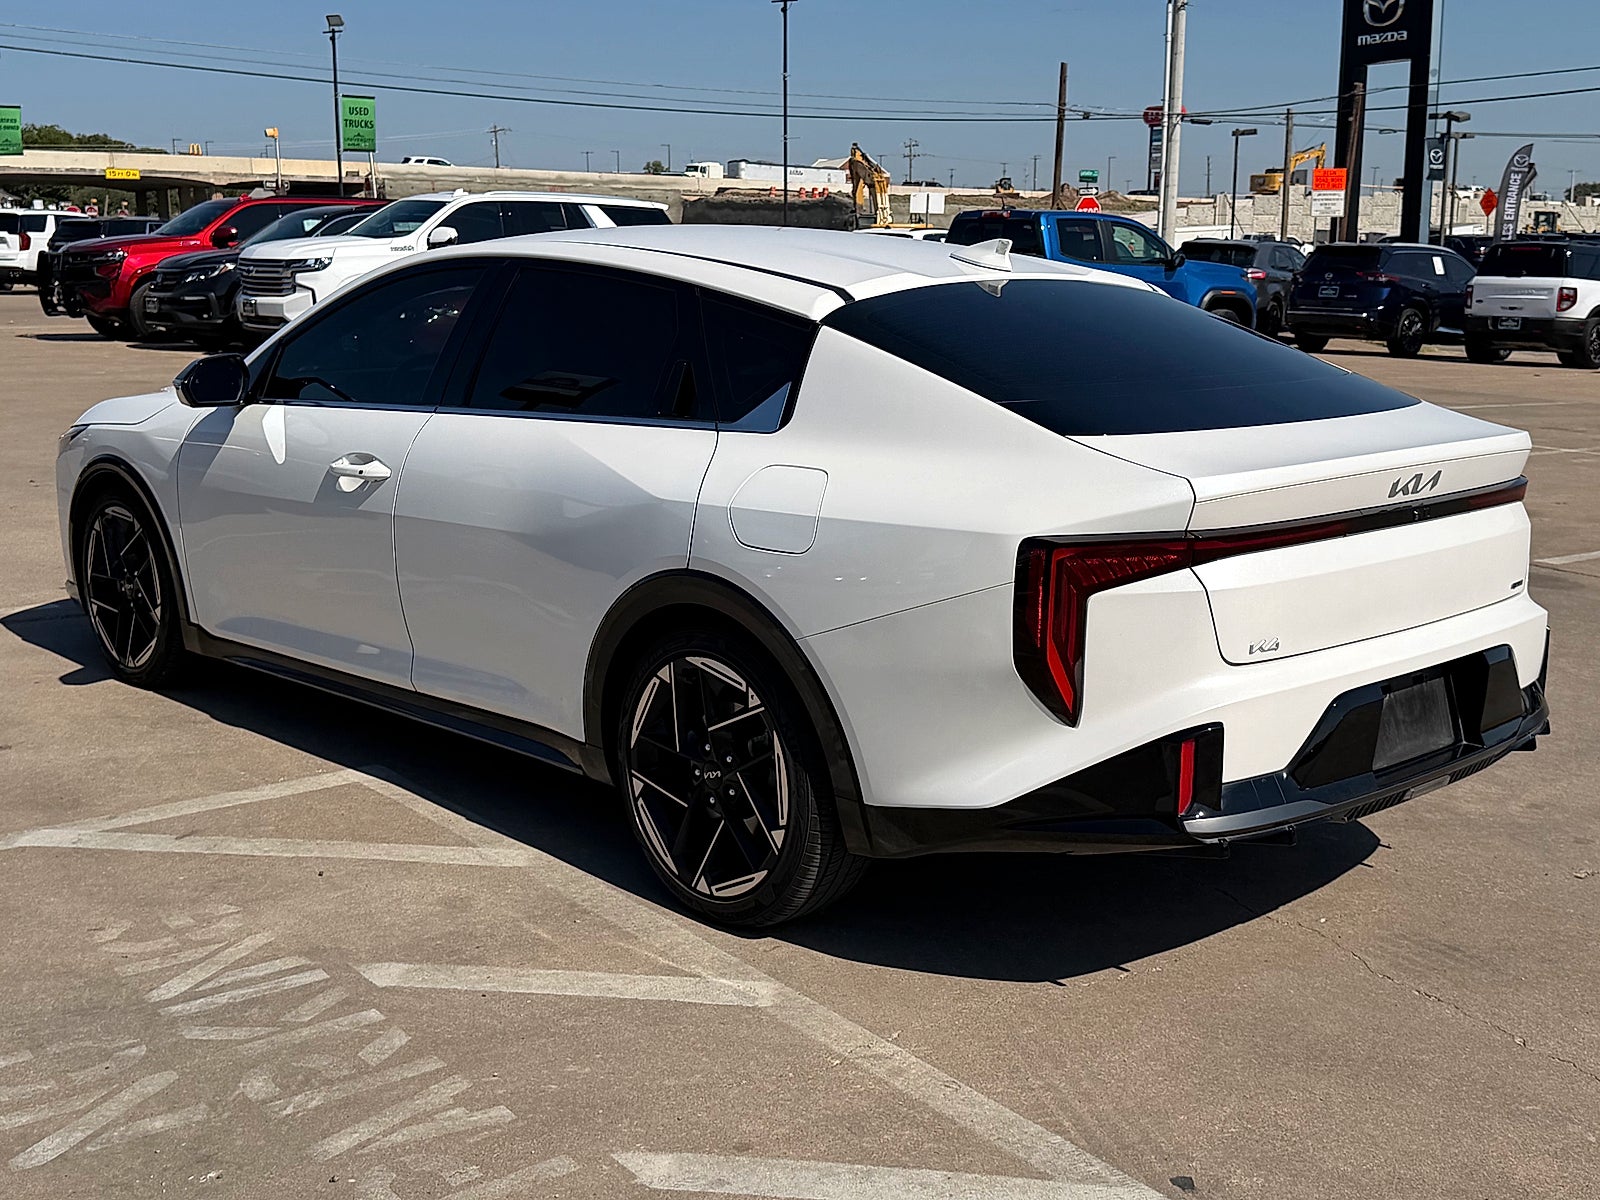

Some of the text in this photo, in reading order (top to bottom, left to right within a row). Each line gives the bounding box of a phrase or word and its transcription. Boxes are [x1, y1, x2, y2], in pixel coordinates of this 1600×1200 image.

[1357, 30, 1408, 46] mazda
[348, 106, 370, 116] USED
[343, 119, 374, 129] TRUCKS
[1504, 172, 1522, 221] ENTRANCE
